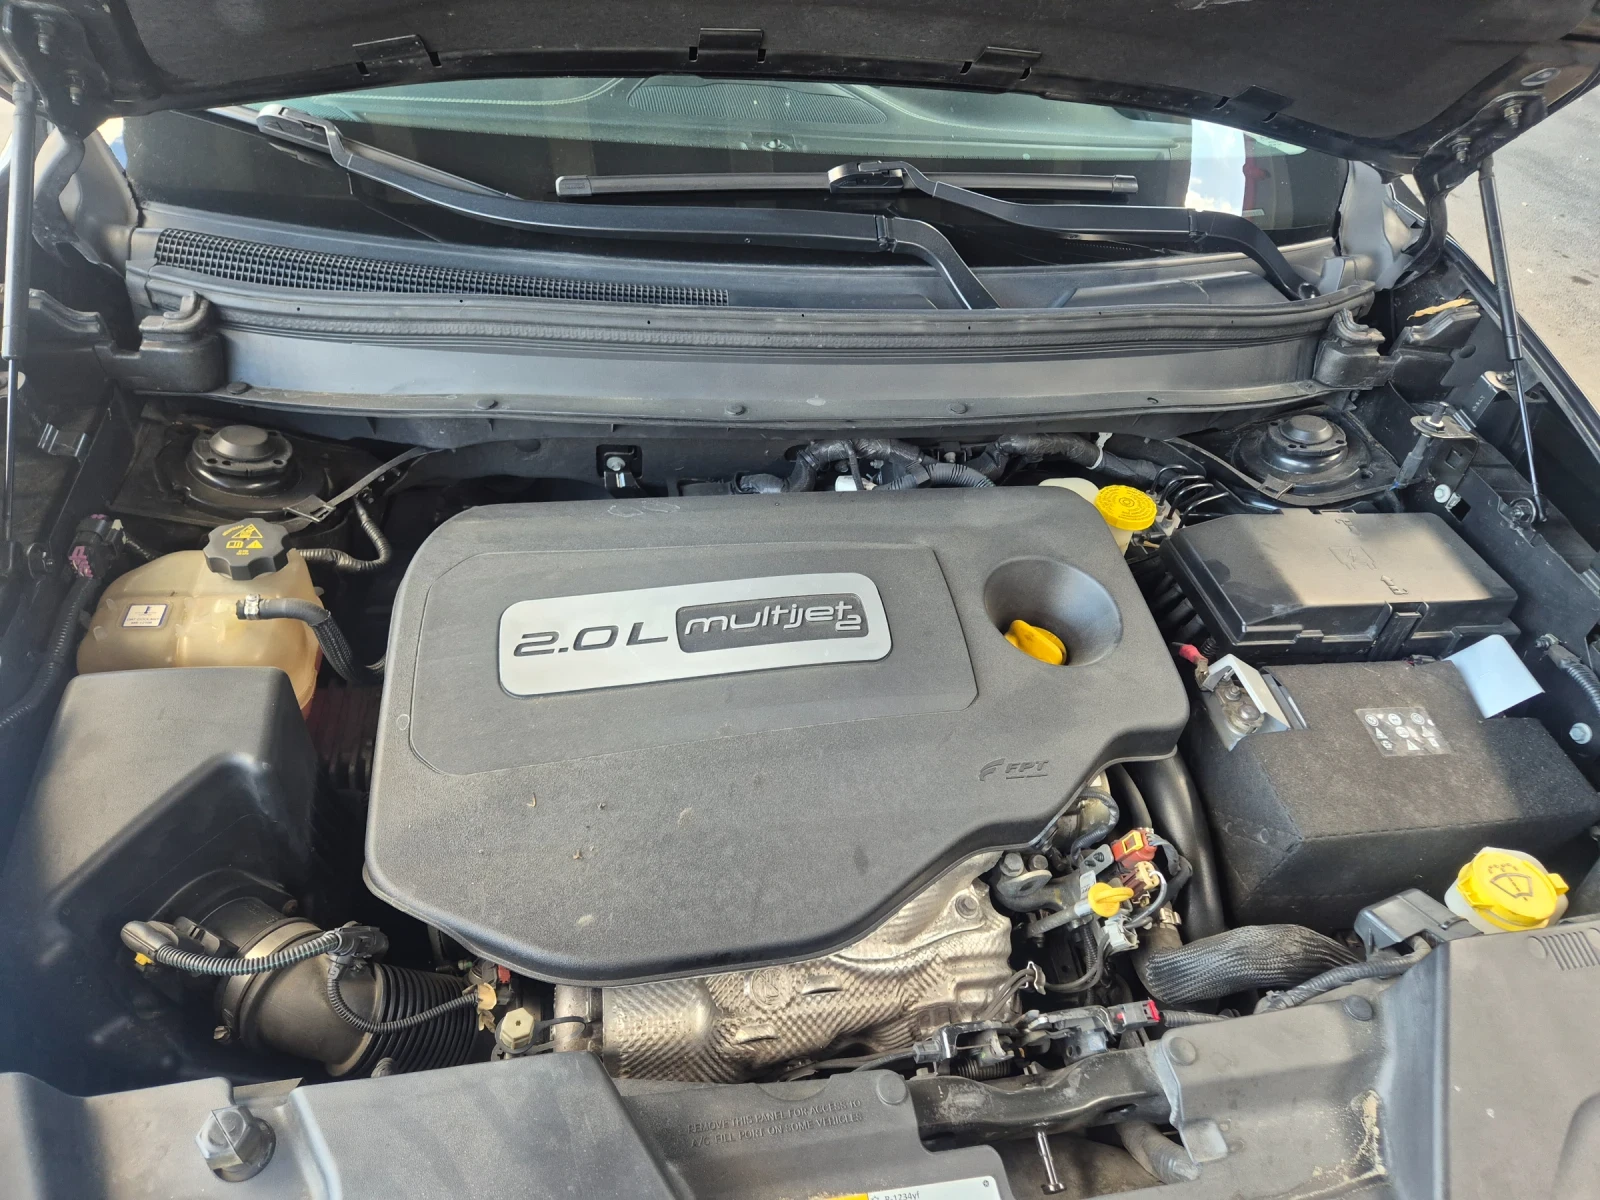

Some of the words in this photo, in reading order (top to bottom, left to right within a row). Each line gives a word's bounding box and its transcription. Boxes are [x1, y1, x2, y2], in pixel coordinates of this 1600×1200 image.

[684, 600, 853, 635] multijet
[1005, 760, 1049, 774] FPT
[687, 1119, 729, 1134] REMOVE
[731, 1115, 754, 1127] THIS
[755, 1111, 785, 1124] PANEL
[787, 1106, 809, 1118] FOR
[809, 1101, 848, 1115] ACCESS
[849, 1099, 862, 1109] TO
[691, 1135, 711, 1148] A/C
[714, 1132, 736, 1144] FILL
[738, 1128, 765, 1141] PORT
[767, 1124, 784, 1135] ON
[784, 1119, 814, 1133] SOME
[815, 1112, 864, 1127] VEHICLES
